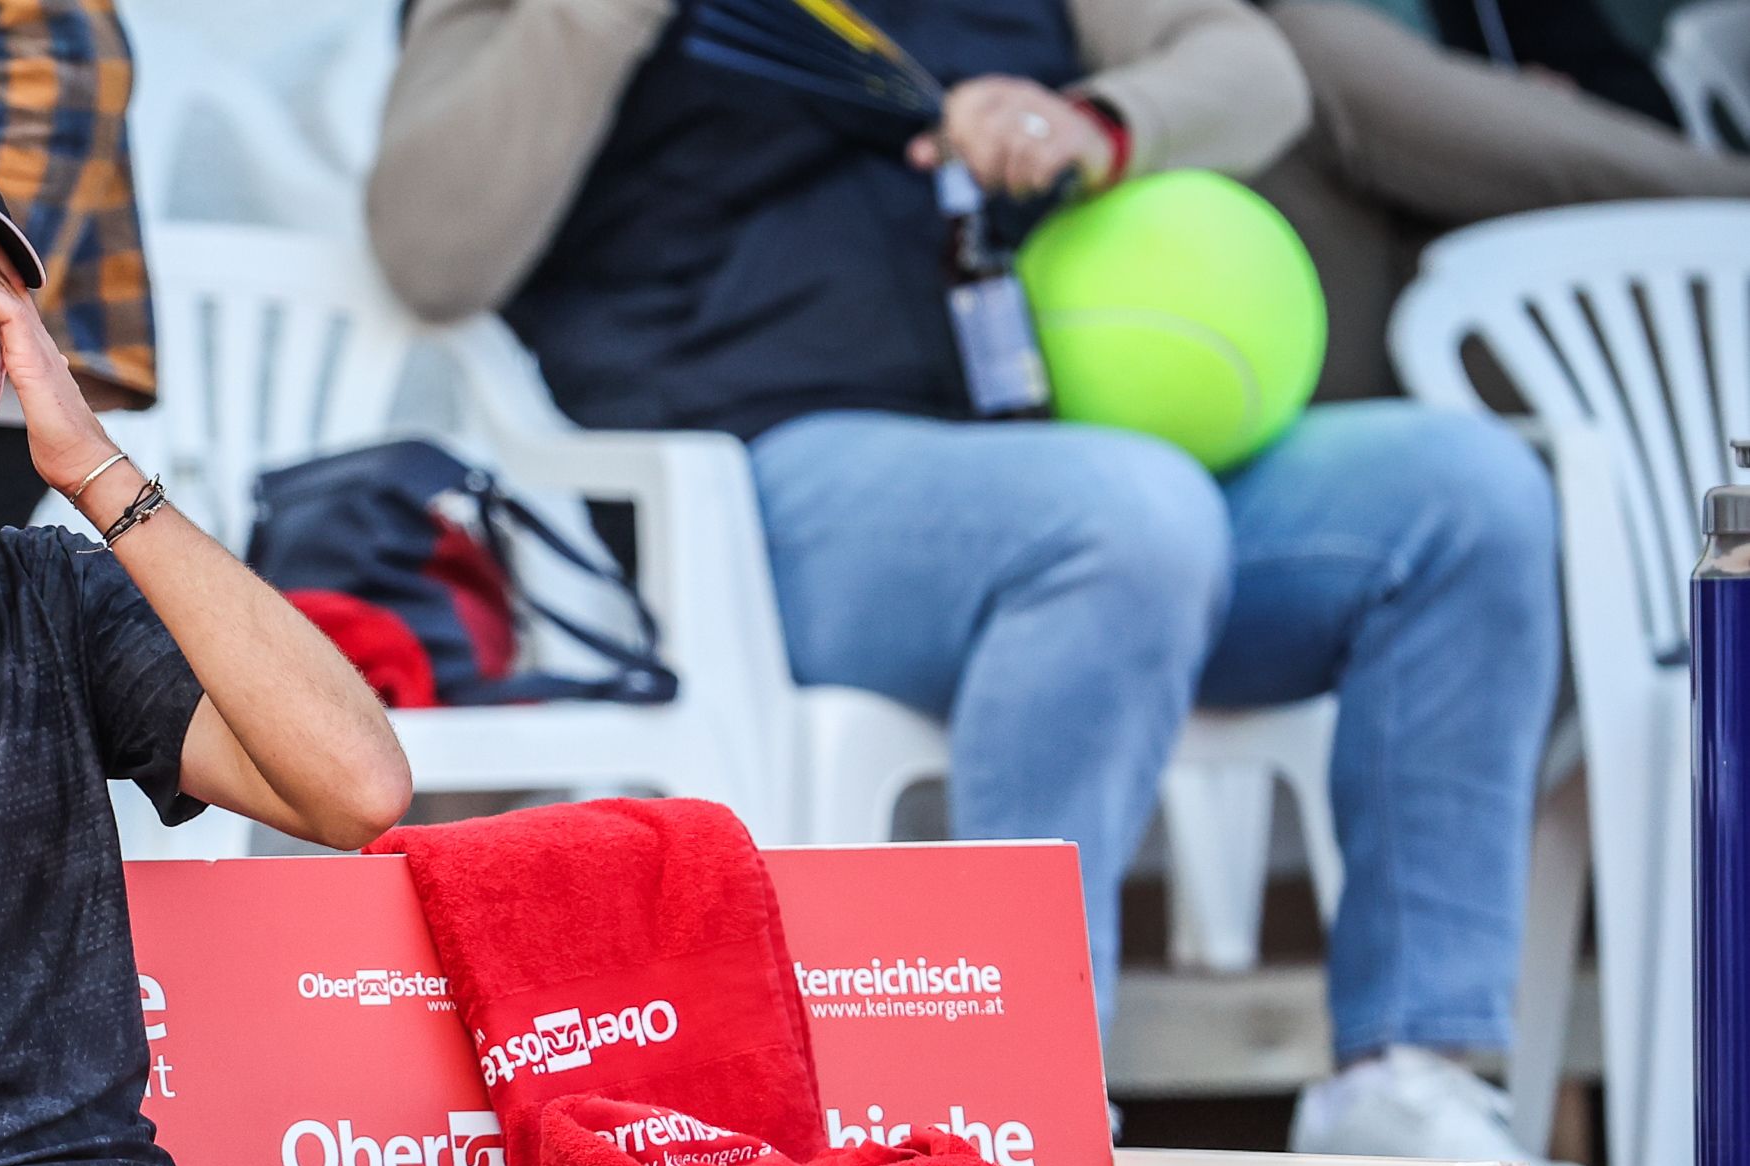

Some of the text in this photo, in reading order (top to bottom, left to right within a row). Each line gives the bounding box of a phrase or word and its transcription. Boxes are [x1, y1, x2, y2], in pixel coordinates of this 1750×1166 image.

[298, 970, 452, 998] Ober öster
[794, 957, 1001, 997] terreichische
[810, 996, 1004, 1022] www.keinesorgen.at
